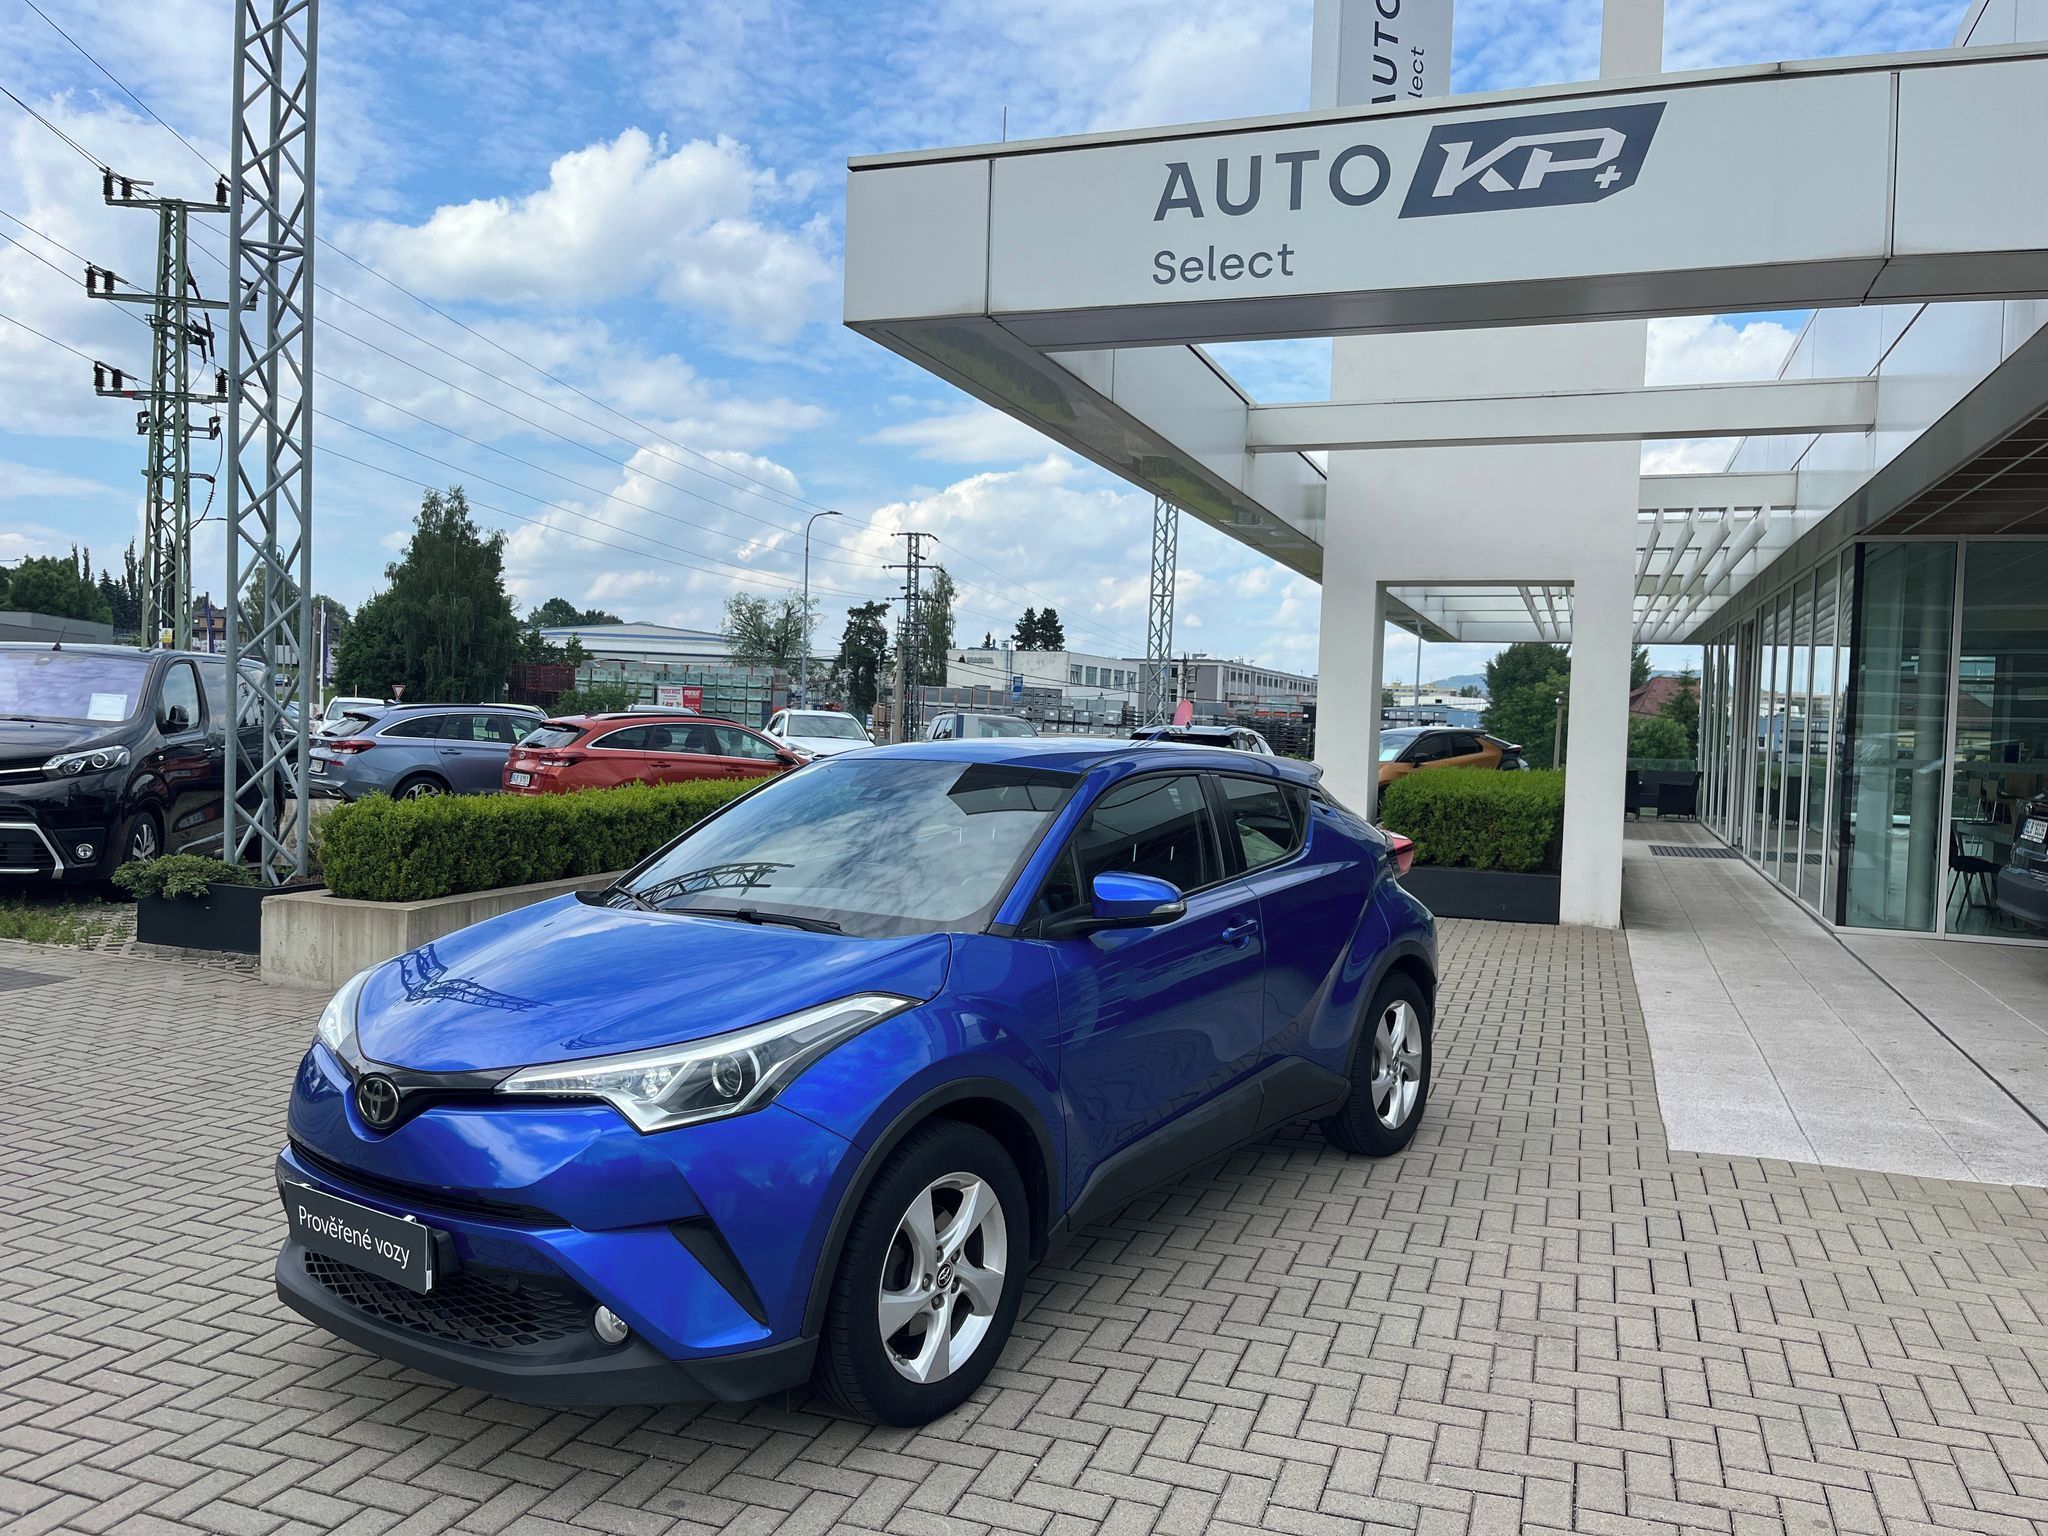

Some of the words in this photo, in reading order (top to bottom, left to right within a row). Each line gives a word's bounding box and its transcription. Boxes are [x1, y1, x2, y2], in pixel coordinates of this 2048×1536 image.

[1154, 144, 1391, 221] AUTO
[1153, 243, 1294, 284] Select
[298, 1205, 372, 1250] Prověřené
[375, 1237, 410, 1269] vozy
